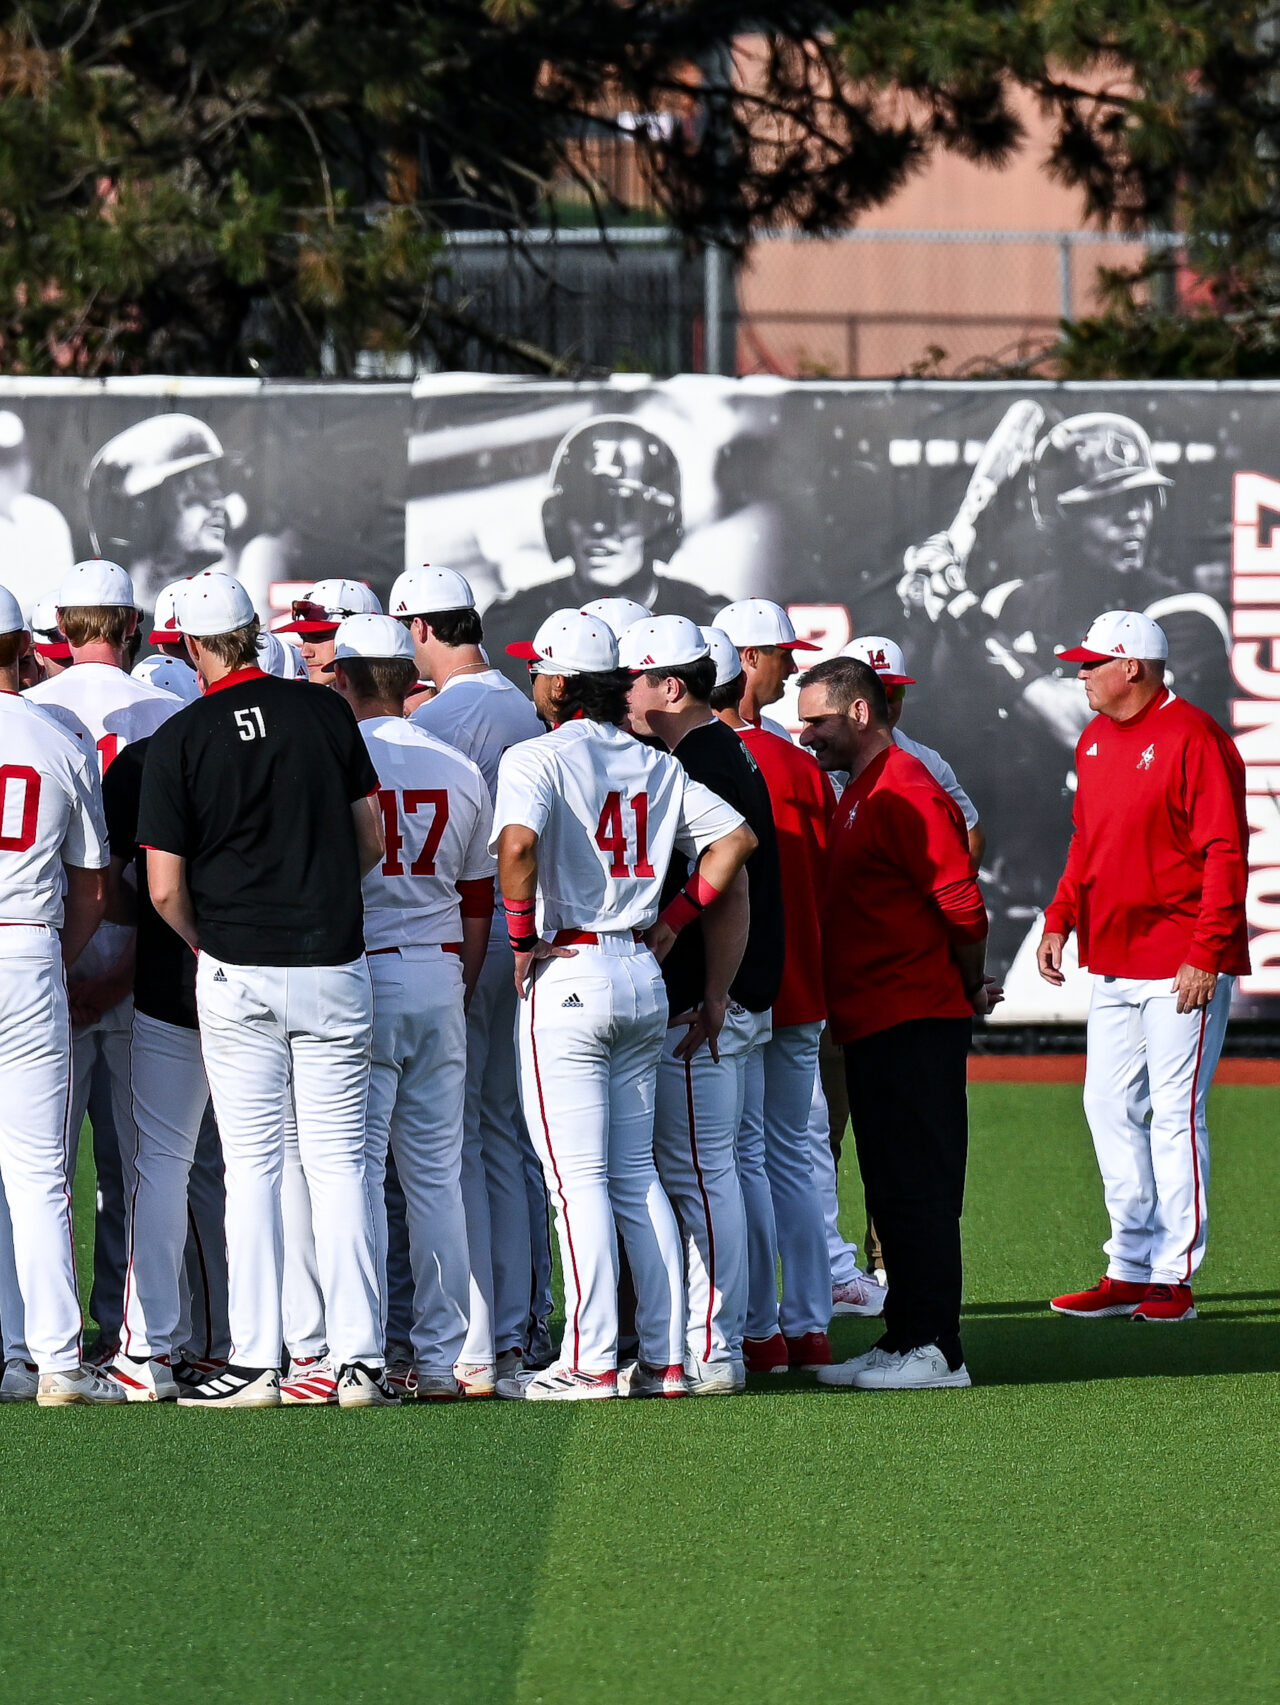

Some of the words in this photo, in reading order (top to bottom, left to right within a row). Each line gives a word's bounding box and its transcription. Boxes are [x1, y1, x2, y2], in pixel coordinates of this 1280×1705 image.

[233, 706, 267, 742] 51
[1230, 470, 1280, 995] NGUEZ
[379, 789, 449, 877] 47
[594, 791, 656, 878] 41
